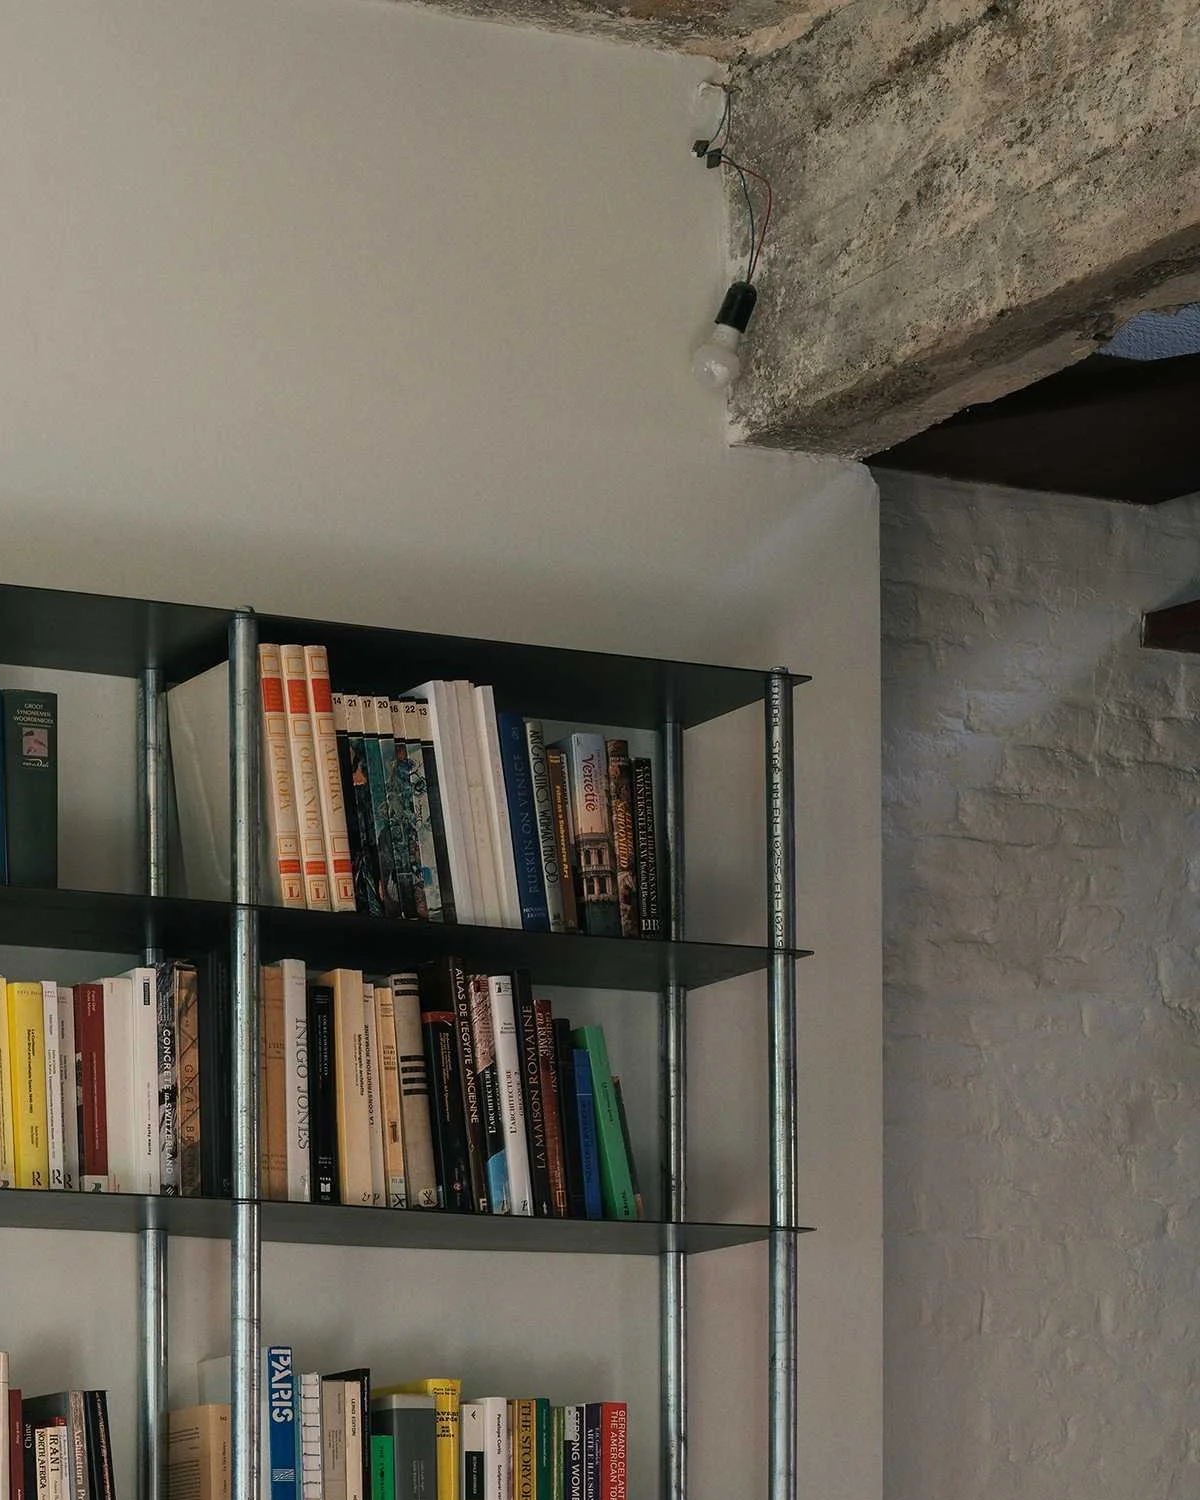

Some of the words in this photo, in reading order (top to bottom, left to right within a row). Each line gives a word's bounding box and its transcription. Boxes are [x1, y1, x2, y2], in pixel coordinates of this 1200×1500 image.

[271, 1349, 293, 1422] PARIS
[522, 1402, 531, 1432] THE
[610, 1411, 618, 1428] THE
[521, 1436, 531, 1483] STORY
